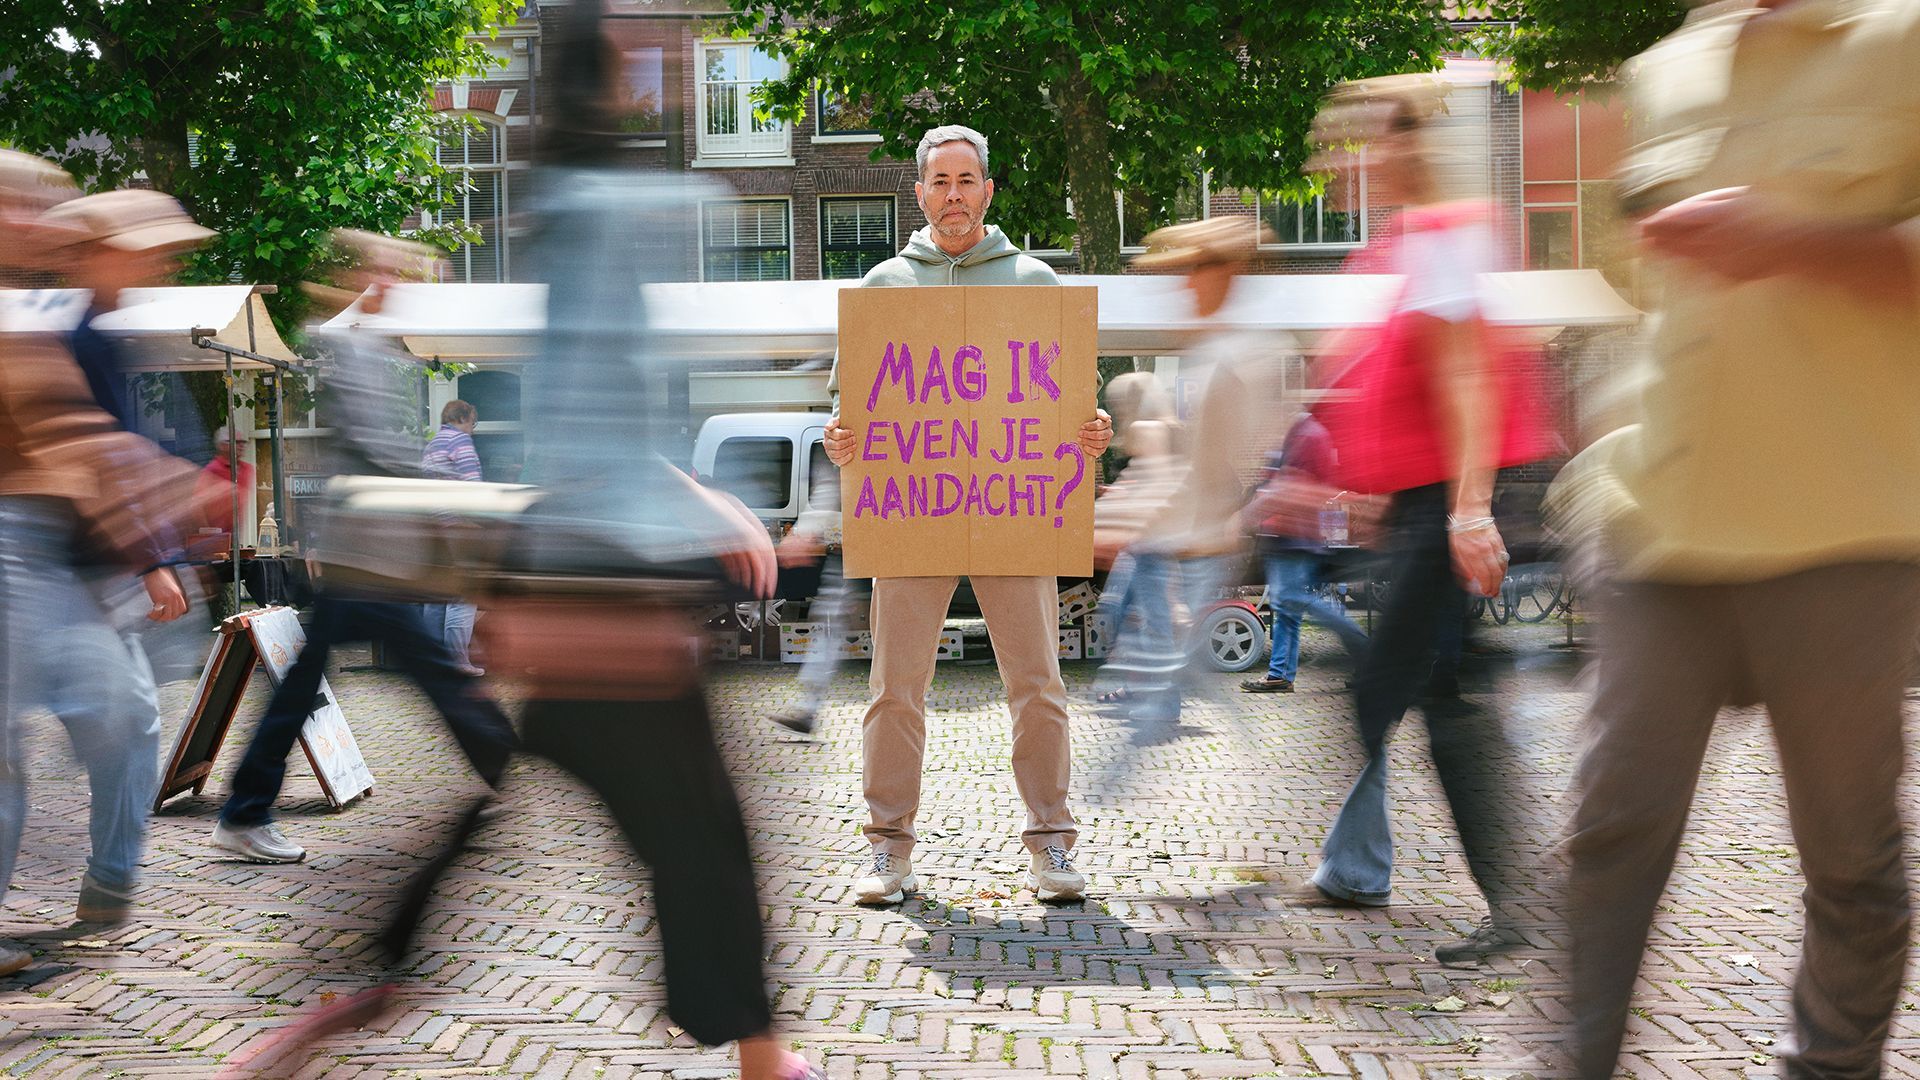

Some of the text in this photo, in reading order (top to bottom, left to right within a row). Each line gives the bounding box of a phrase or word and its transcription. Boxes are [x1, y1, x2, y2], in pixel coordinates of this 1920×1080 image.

[866, 340, 1062, 413] MAG IK
[862, 418, 1044, 465] EVEN JE
[854, 441, 1086, 529] AANDACHT?
